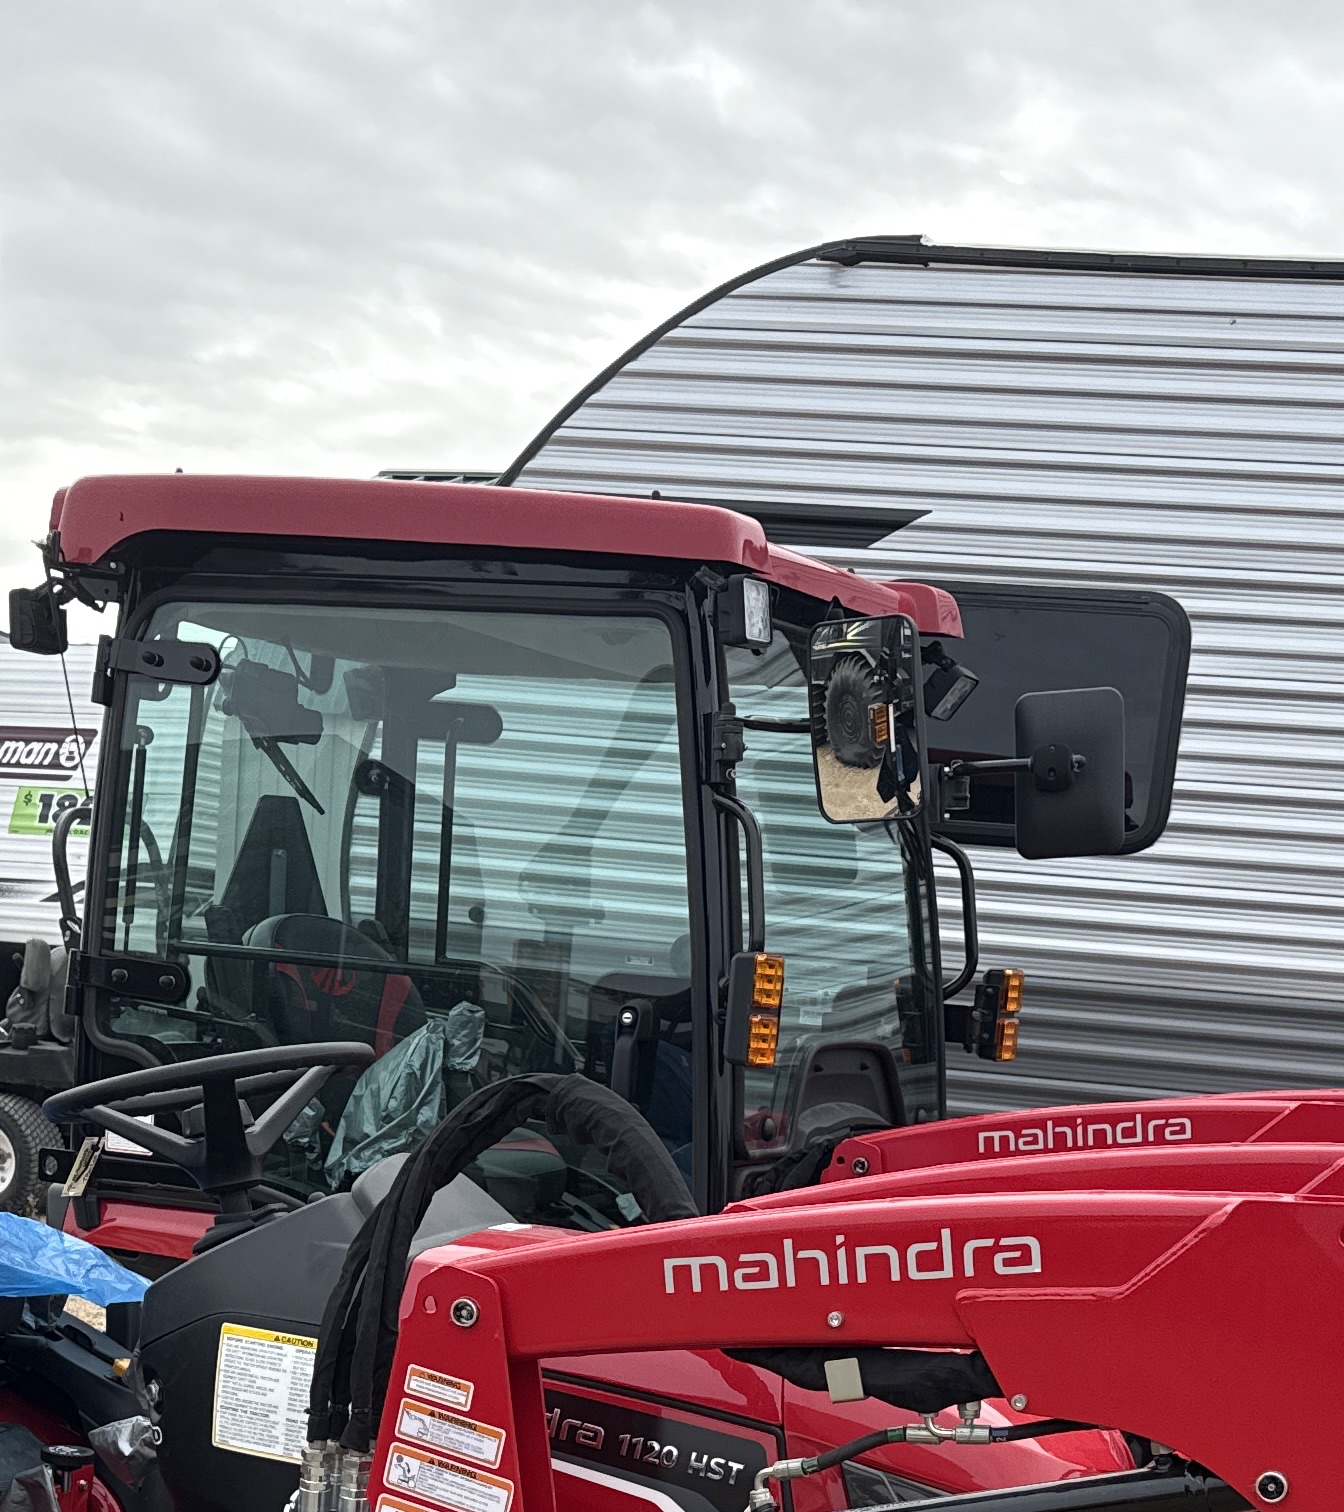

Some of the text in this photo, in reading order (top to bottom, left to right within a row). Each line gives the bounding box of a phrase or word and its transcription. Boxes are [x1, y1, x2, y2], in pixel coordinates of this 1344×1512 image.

[977, 1114, 1193, 1153] mahindra
[663, 1228, 1043, 1294] mahindra
[281, 1336, 314, 1348] CAUTION
[618, 1433, 679, 1469] 1120
[687, 1451, 745, 1485] HST
